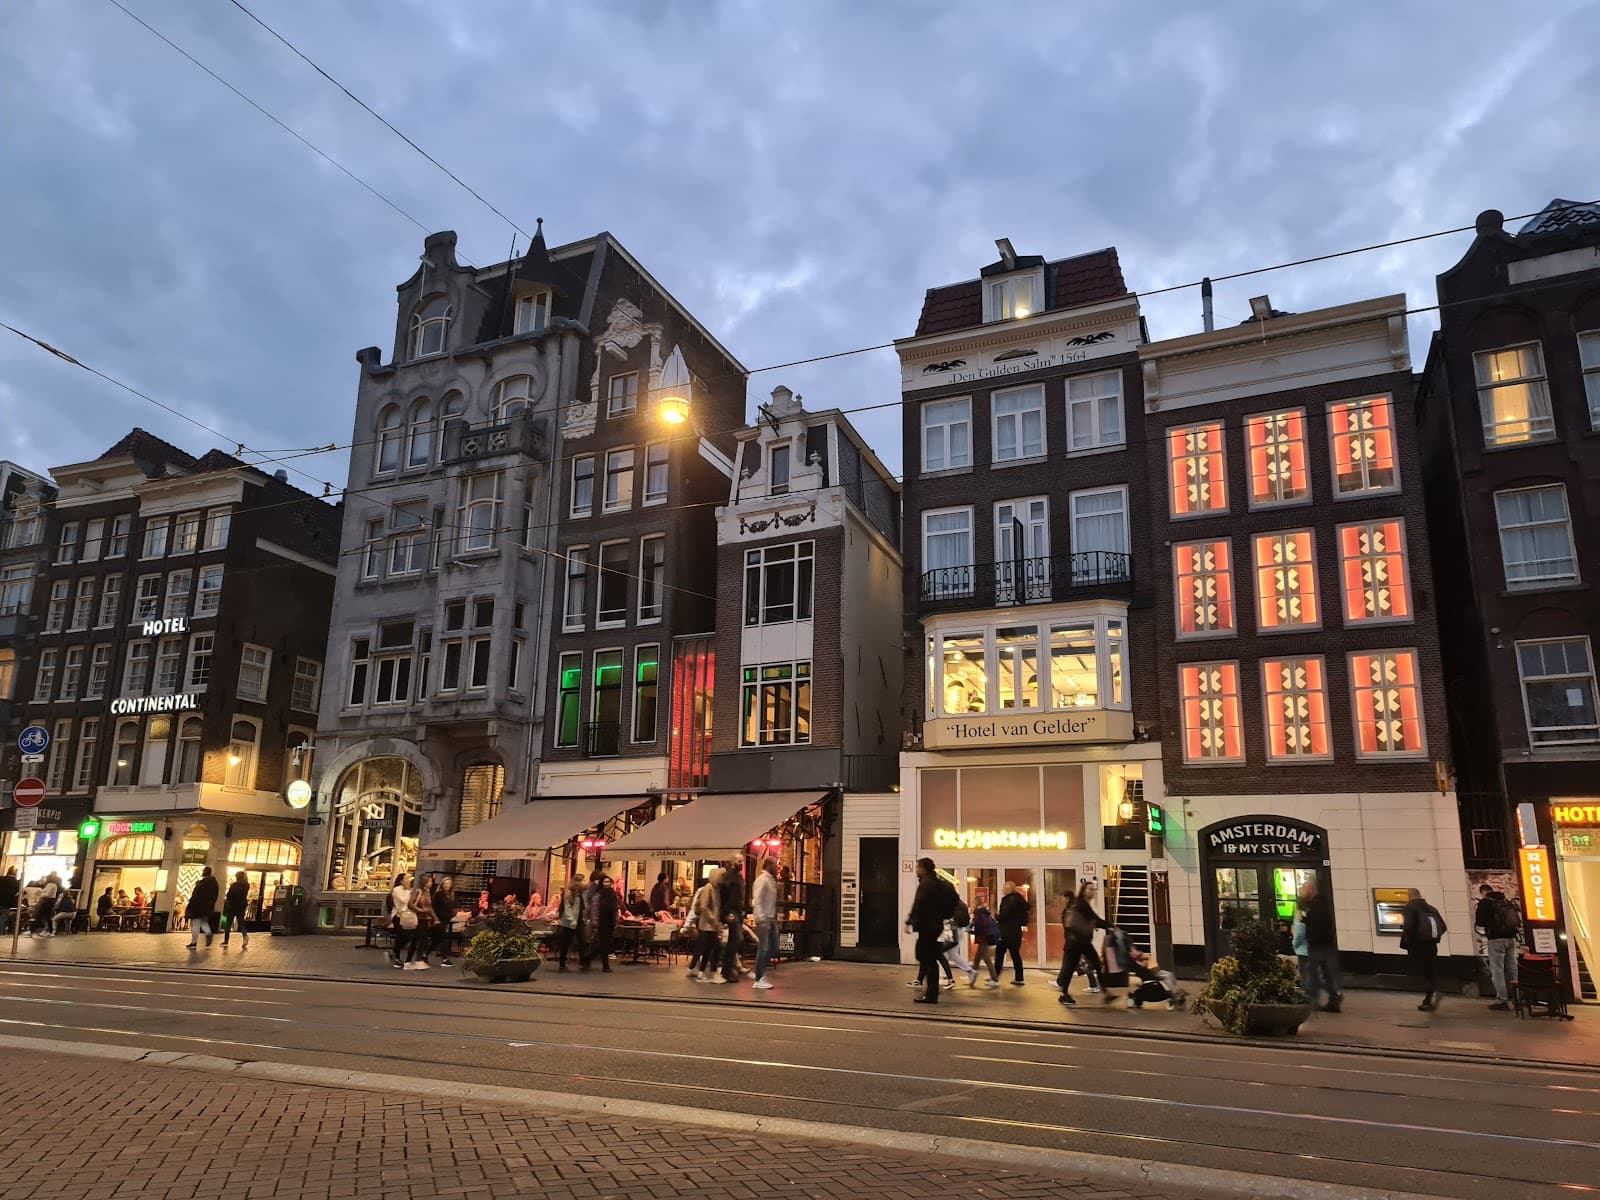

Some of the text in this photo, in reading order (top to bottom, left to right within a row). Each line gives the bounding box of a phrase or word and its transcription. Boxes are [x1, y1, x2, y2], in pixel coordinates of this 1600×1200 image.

[1061, 351, 1087, 365] 1564
[143, 617, 185, 635] HOTEL
[111, 694, 196, 714] CONTINENTAL
[1001, 725, 1028, 736] van
[1210, 824, 1314, 846] AMSTERDAM
[1239, 844, 1258, 853] MY
[1262, 844, 1301, 854] STYLE
[1529, 863, 1547, 919] HOTEL
